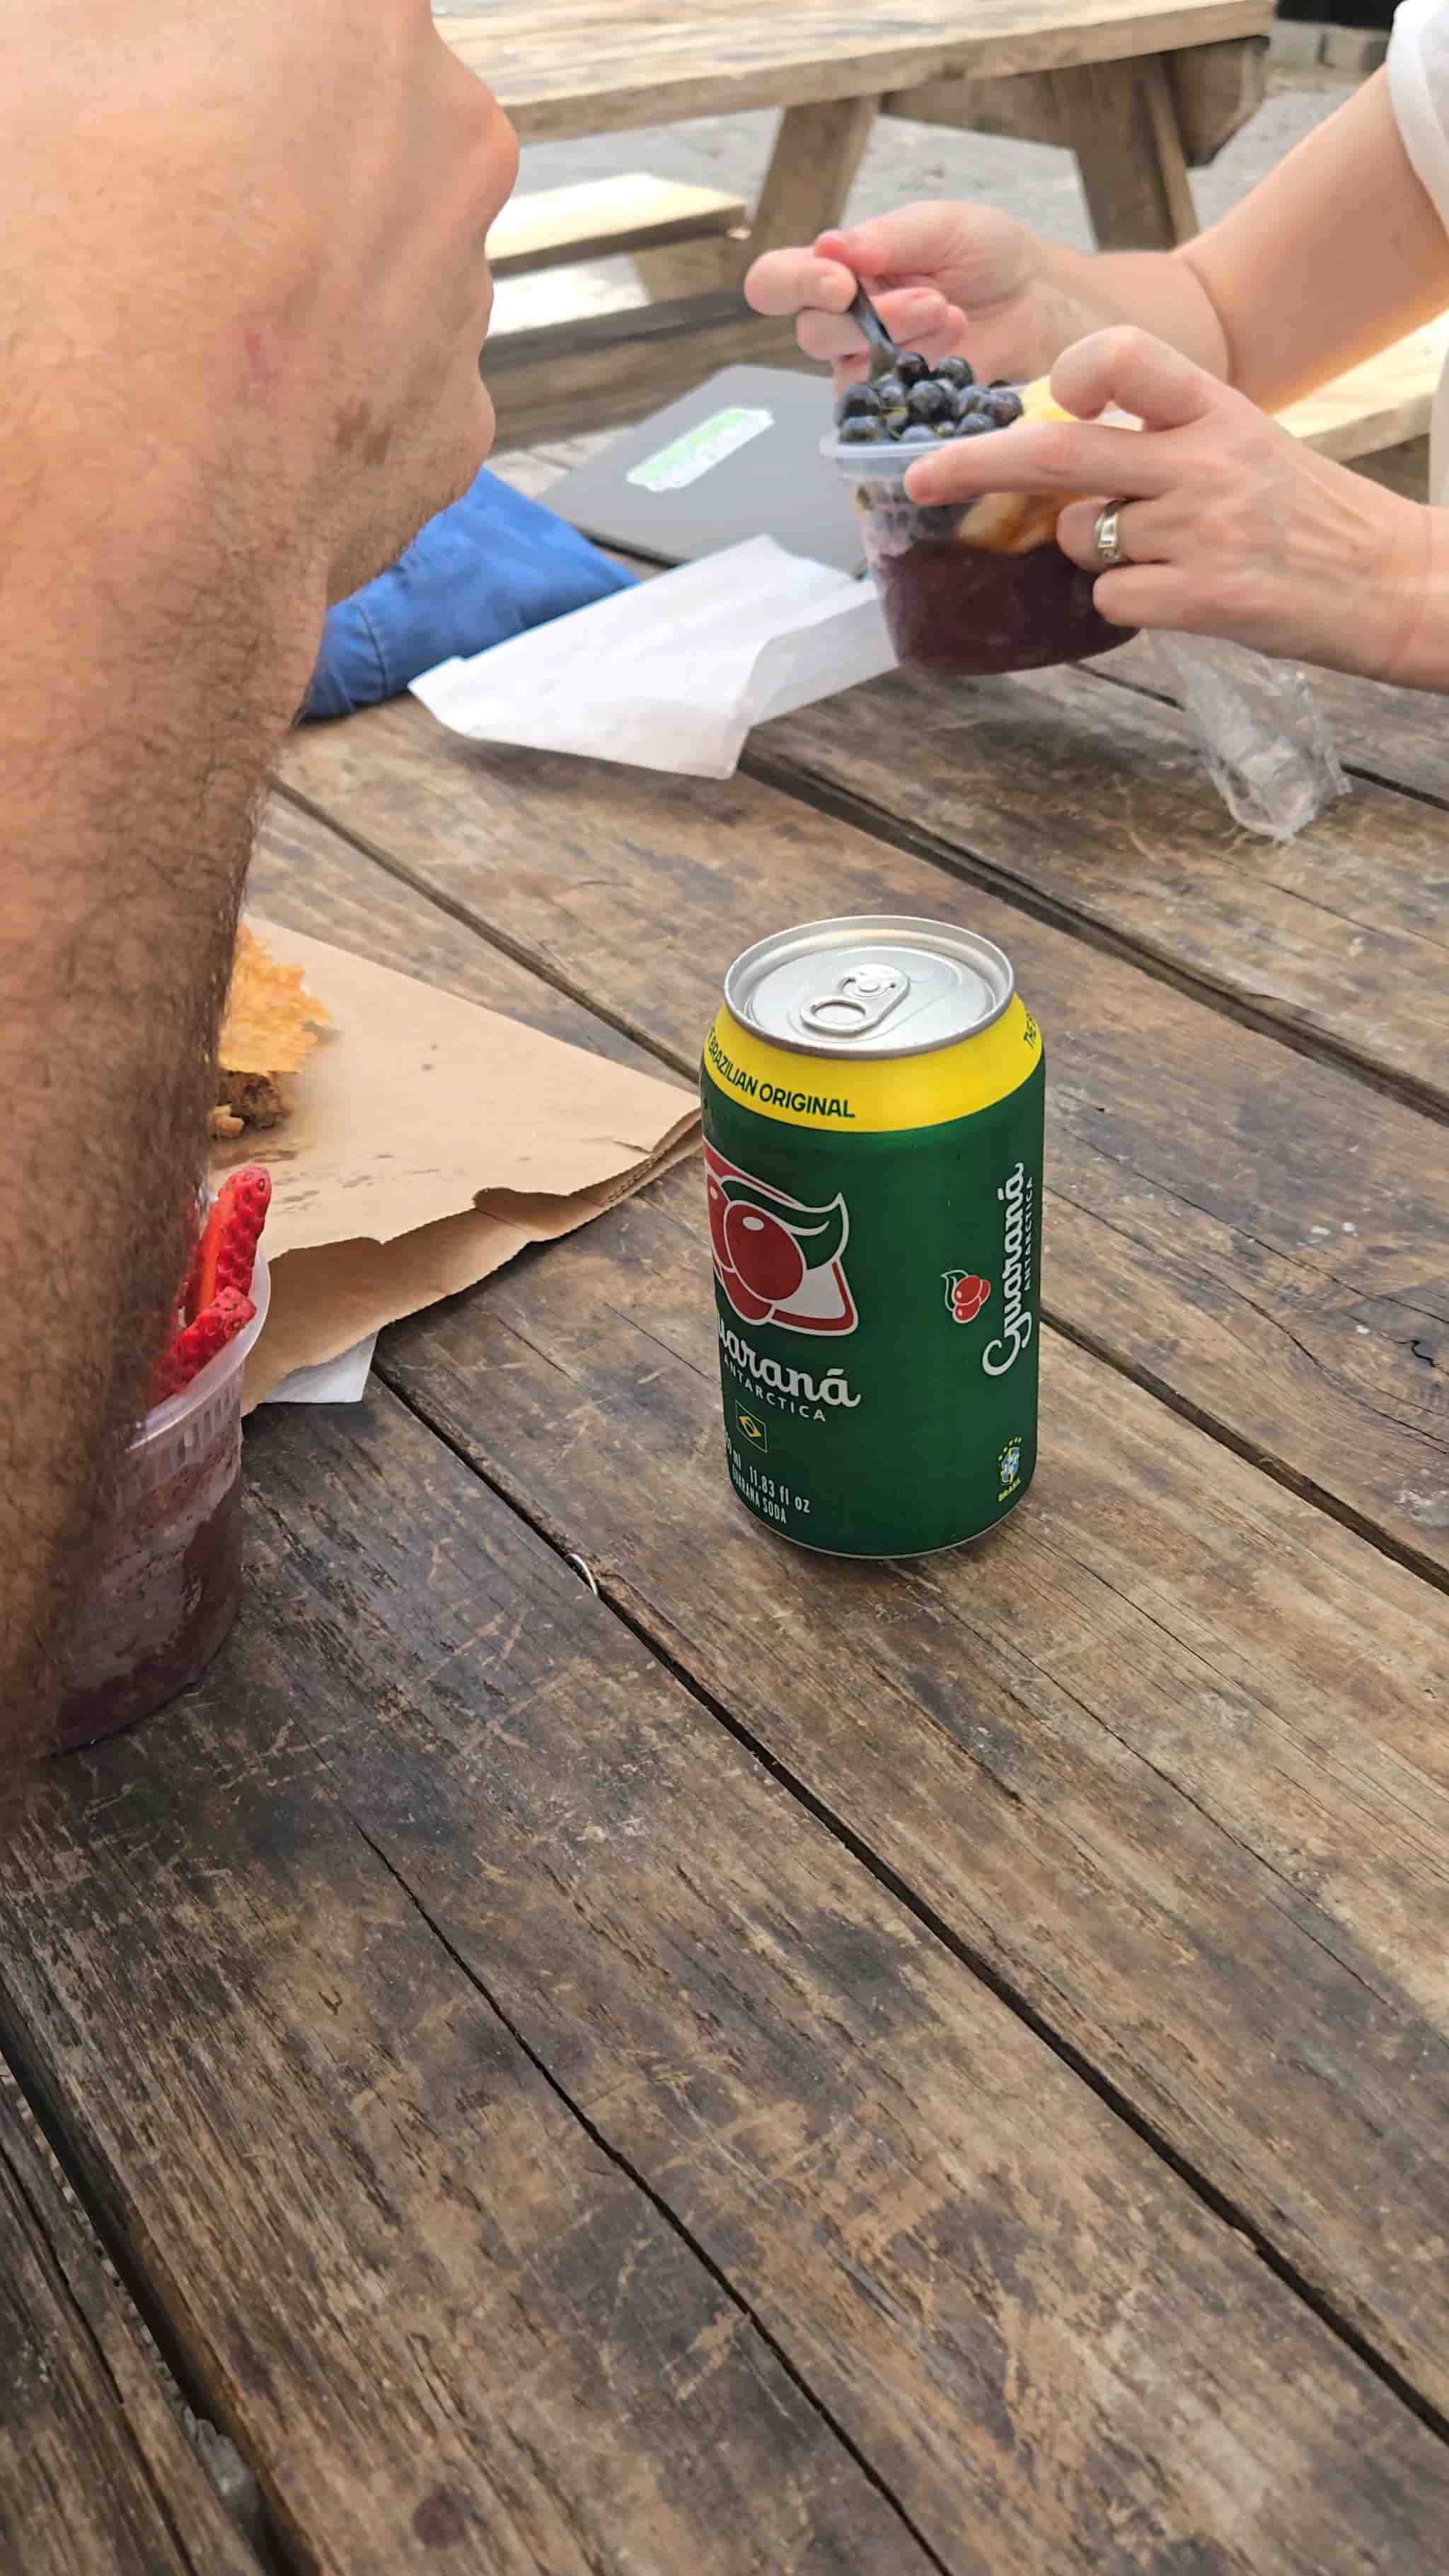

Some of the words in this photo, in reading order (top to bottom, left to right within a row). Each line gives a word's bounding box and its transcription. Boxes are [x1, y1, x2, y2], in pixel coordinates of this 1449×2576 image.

[708, 1036, 758, 1096] BRAZILIAN
[759, 1082, 855, 1119] ORIGINAL
[982, 1162, 1032, 1376] Guaraná
[724, 1353, 826, 1422] ANTARCTICA
[749, 1465, 775, 1498] 11.83
[780, 1485, 790, 1506] fl
[795, 1496, 810, 1513] oz
[762, 1496, 787, 1525] SODA
